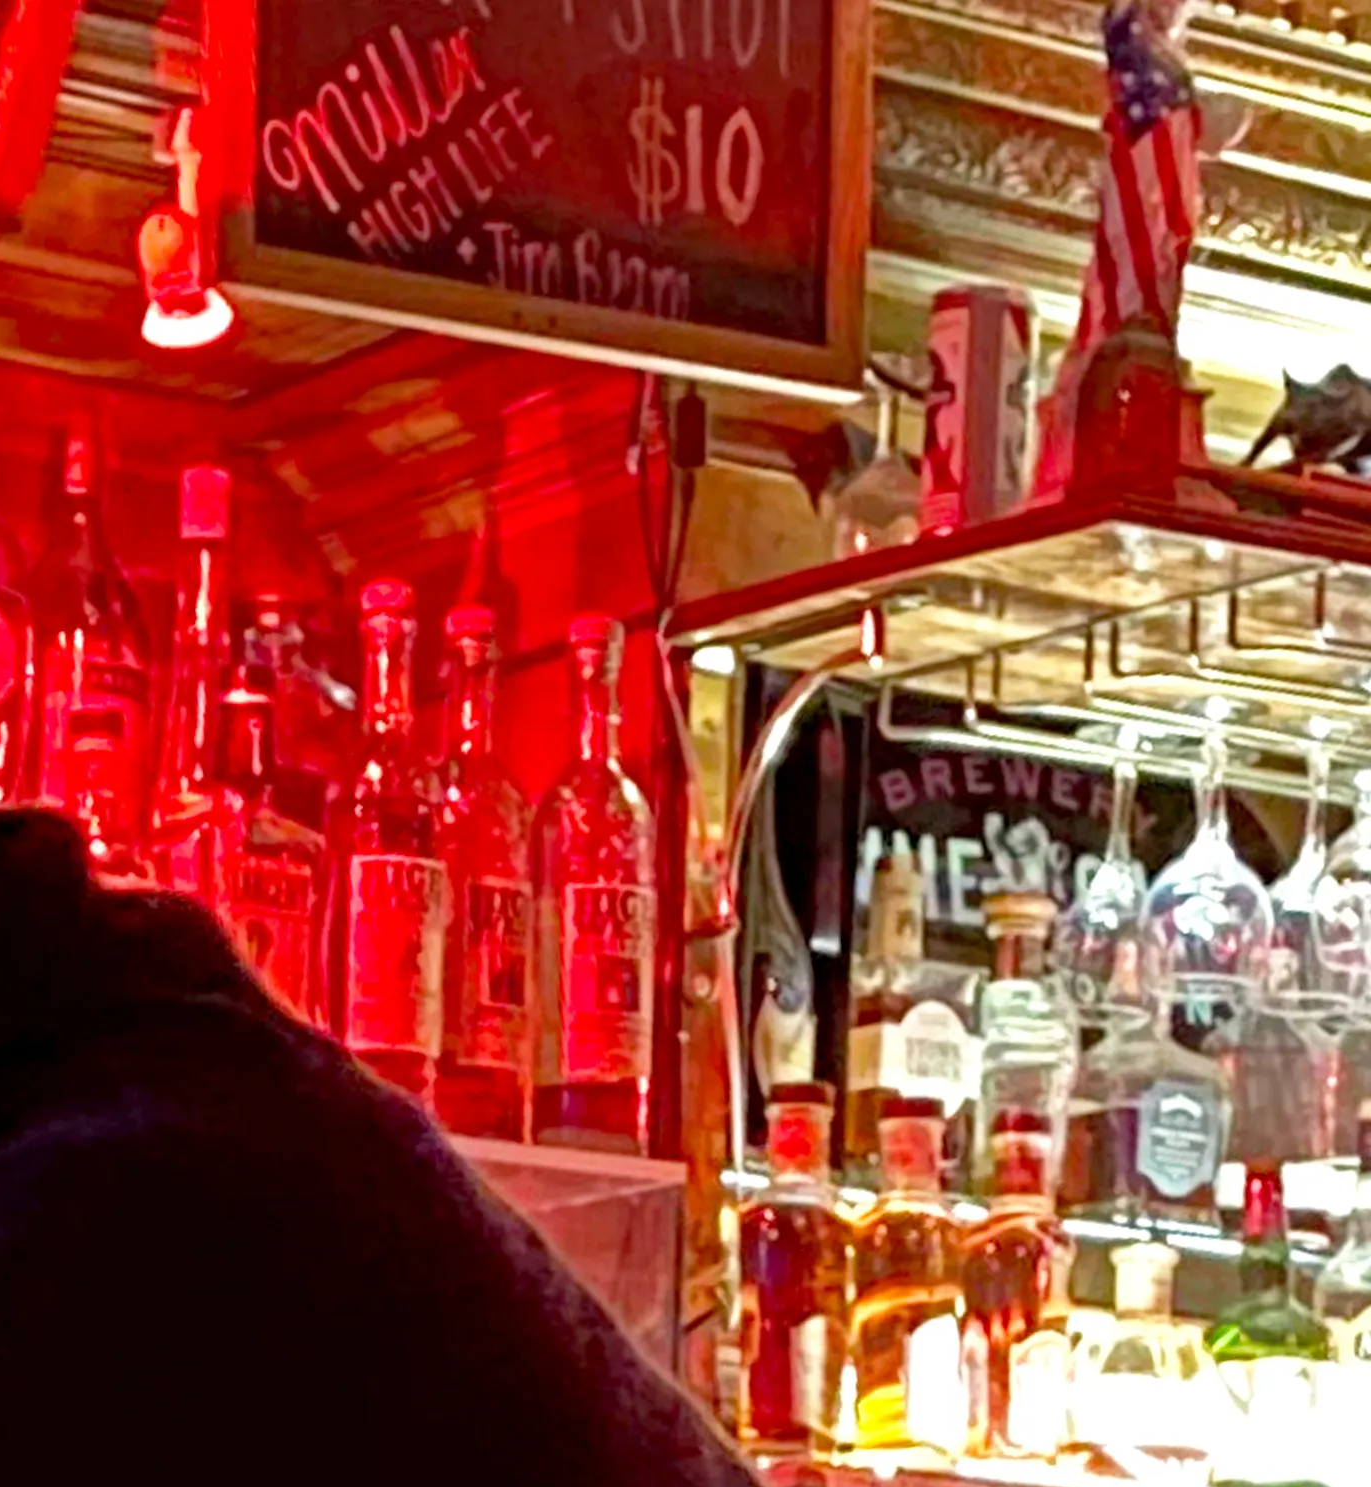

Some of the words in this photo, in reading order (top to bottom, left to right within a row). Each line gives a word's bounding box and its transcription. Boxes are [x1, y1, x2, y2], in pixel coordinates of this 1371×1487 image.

[262, 24, 486, 213] Miller
[348, 154, 464, 262] HIGH
[448, 86, 555, 204] LIFE
[628, 75, 766, 226] $10
[482, 221, 564, 295] Jim
[573, 228, 691, 320] Beam
[879, 756, 1158, 834] BREWERY
